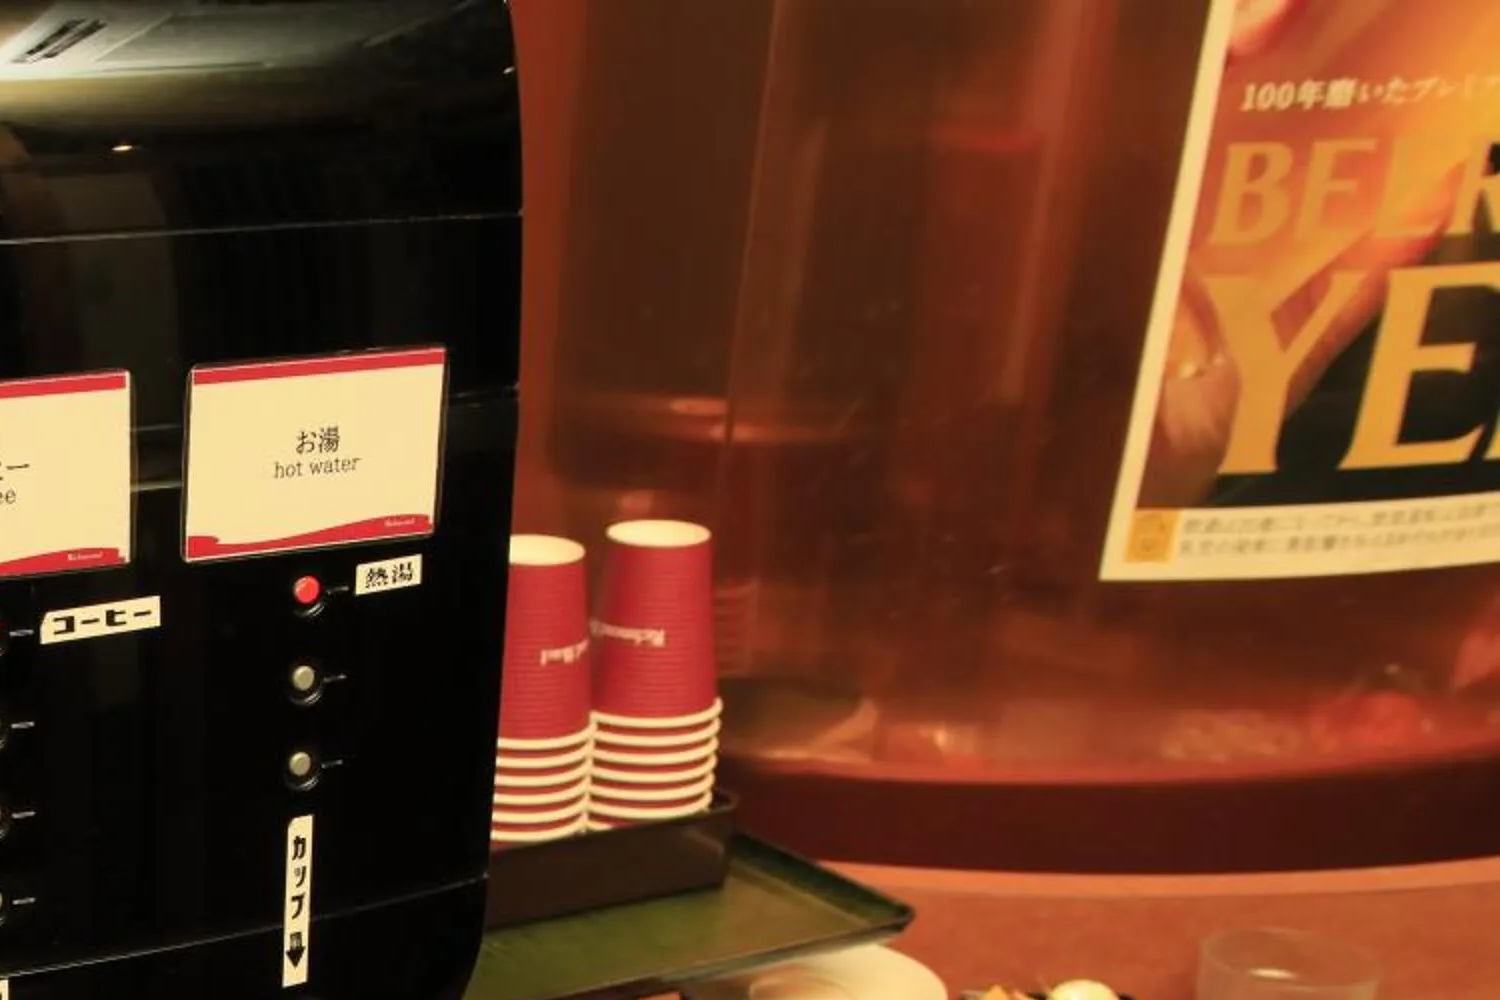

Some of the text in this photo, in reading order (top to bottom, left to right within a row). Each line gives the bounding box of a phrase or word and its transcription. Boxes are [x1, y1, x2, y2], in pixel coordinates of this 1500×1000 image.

[1206, 262, 1500, 474] YE
[295, 426, 341, 454] お湯
[274, 456, 361, 479] hot water
[365, 561, 413, 588] 熱湯
[52, 608, 153, 636] コーヒー
